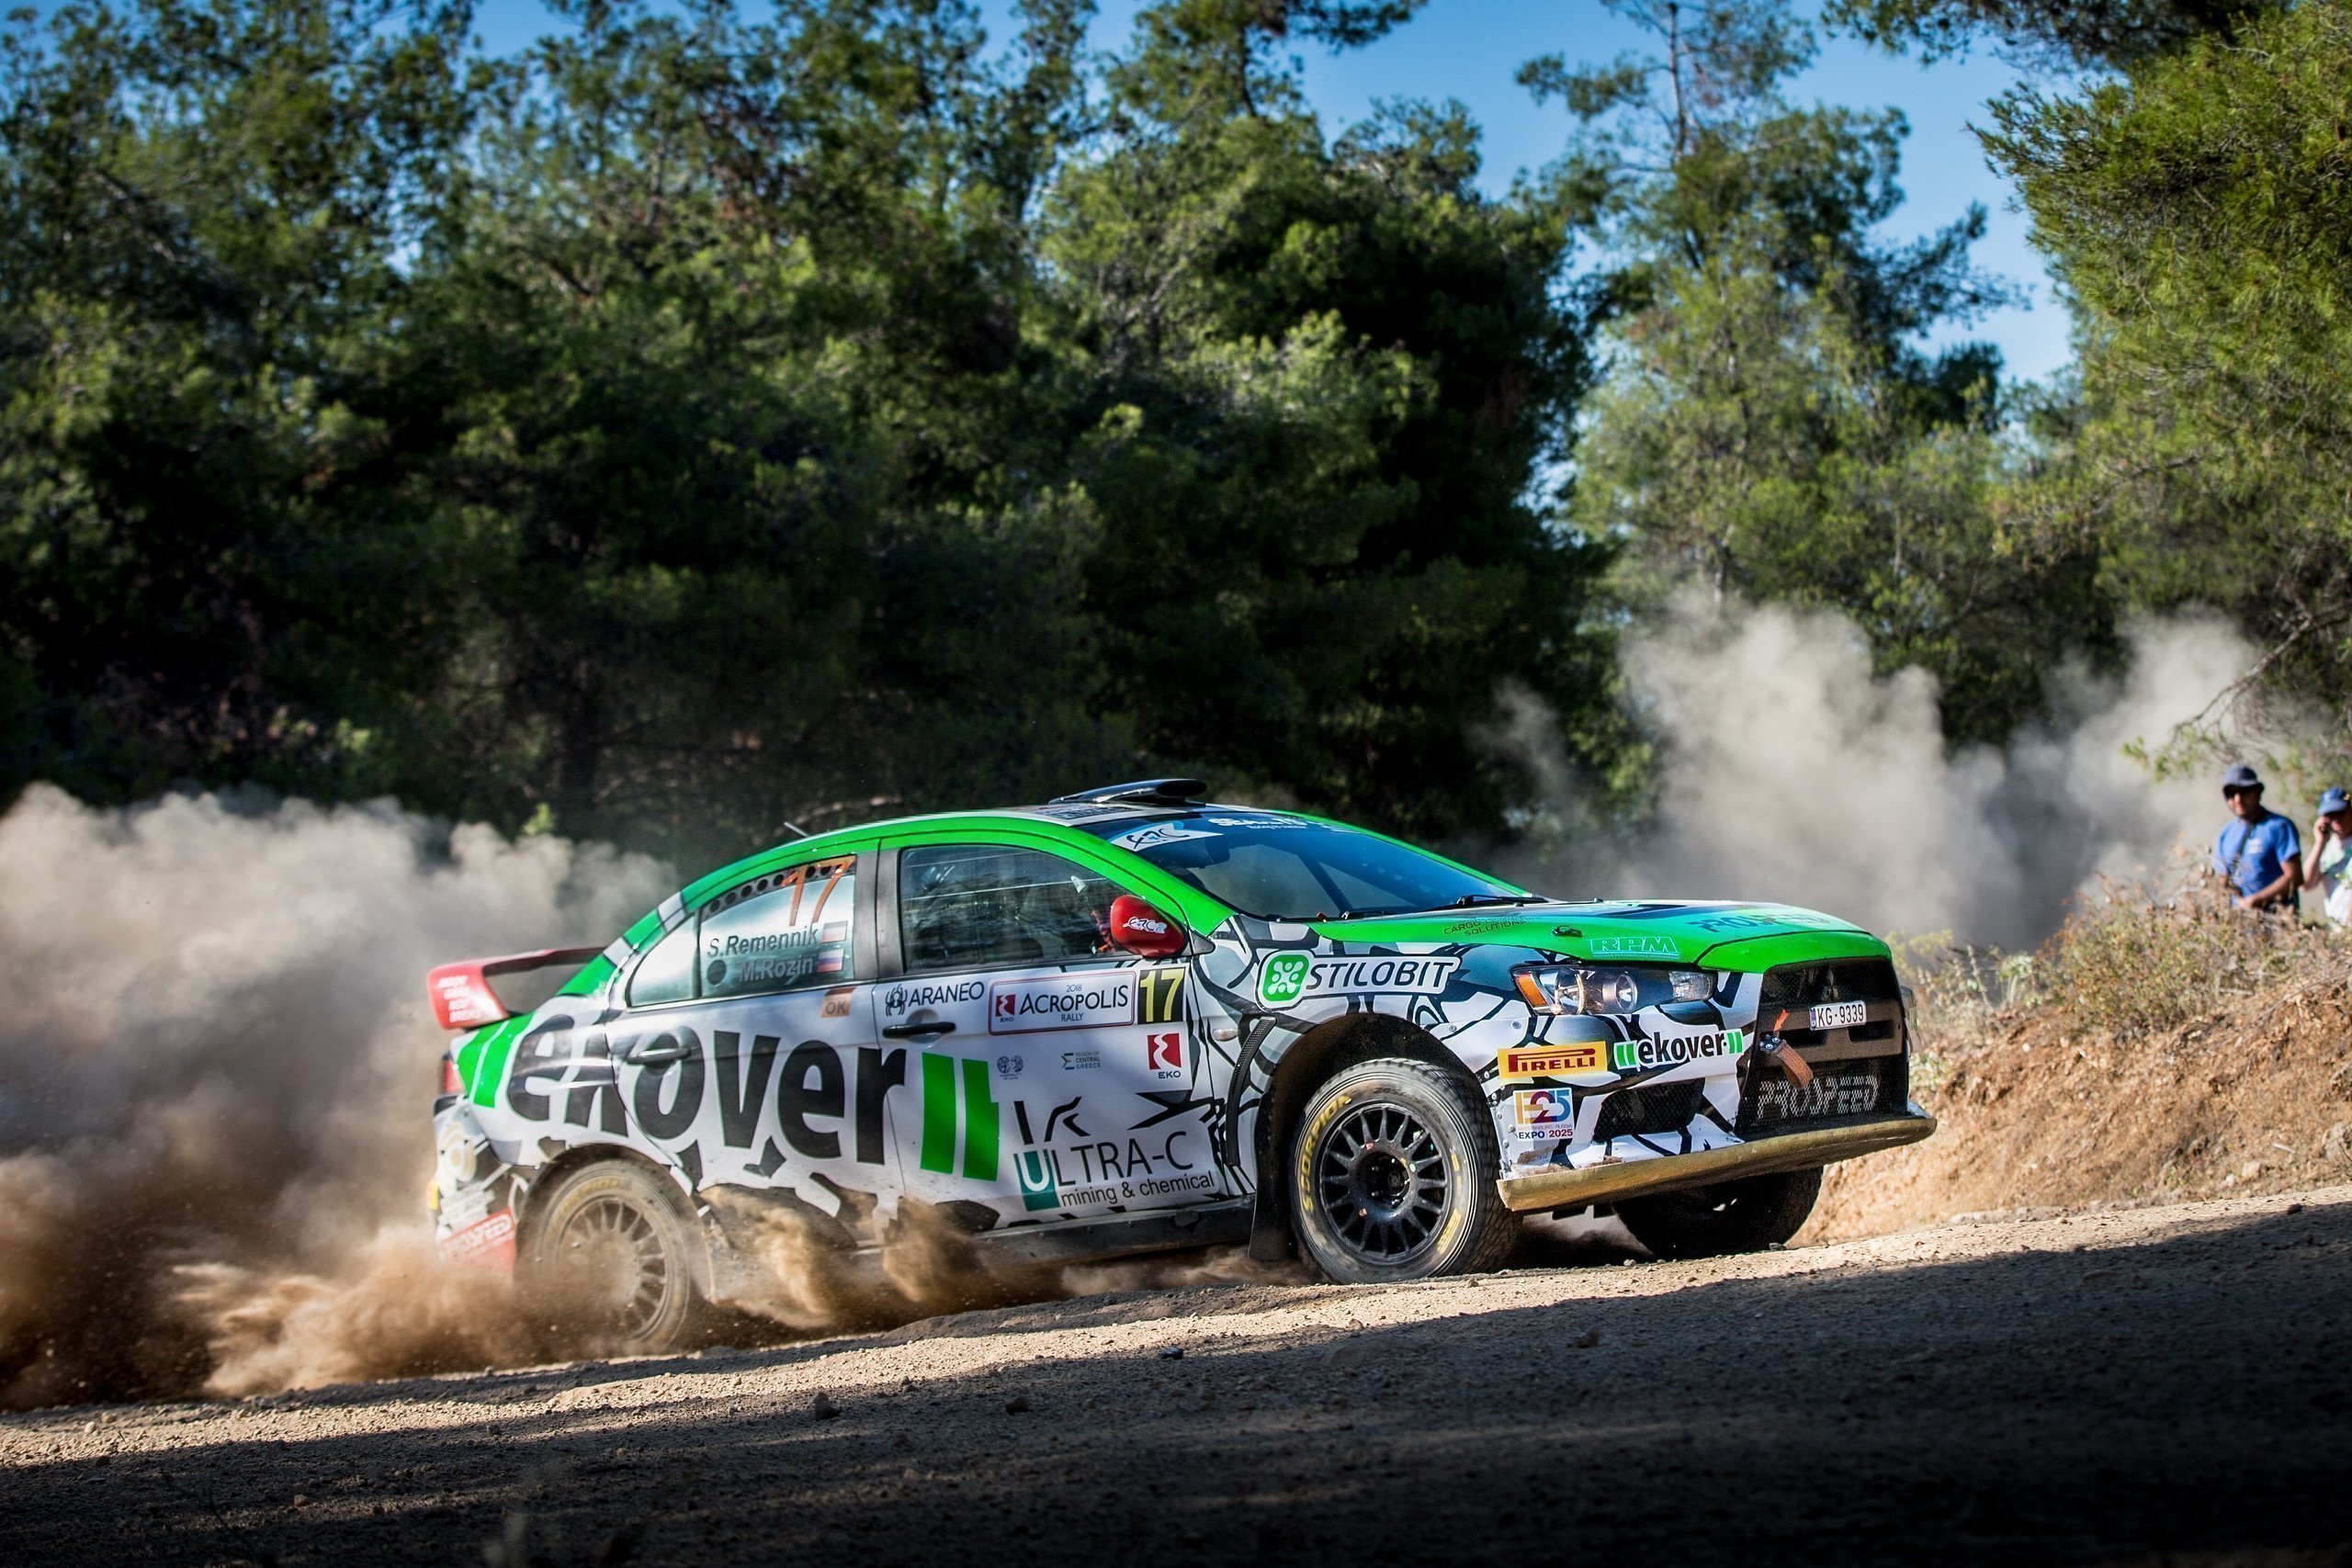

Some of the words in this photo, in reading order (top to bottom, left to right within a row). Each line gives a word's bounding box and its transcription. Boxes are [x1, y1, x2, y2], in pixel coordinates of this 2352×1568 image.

[781, 855, 856, 927] 17
[1443, 920, 1481, 935] CARGO
[707, 926, 820, 958] S.Remennik
[1590, 937, 1679, 953] RPM
[740, 955, 813, 982] M.Rozin
[1306, 962, 1454, 990] STILOBIT
[908, 981, 985, 1008] ARANEO
[1019, 985, 1128, 1015] ACROPOLIS
[1066, 984, 1082, 993] 2018
[1140, 968, 1185, 1022] 17
[825, 1000, 846, 1015] OK
[1060, 1012, 1084, 1022] RALLY
[1508, 1047, 1596, 1073] PIRELLI
[1637, 1032, 1725, 1065] ekover
[1159, 1070, 1182, 1079] EKO
[507, 1013, 906, 1166] ekover
[1518, 1131, 1545, 1139] EXPO
[1548, 1128, 1574, 1138] 2025
[1019, 1130, 1193, 1192] ULTRA-C
[1060, 1186, 1117, 1207] mining
[1121, 1181, 1136, 1198] &
[1138, 1170, 1215, 1197] chemical
